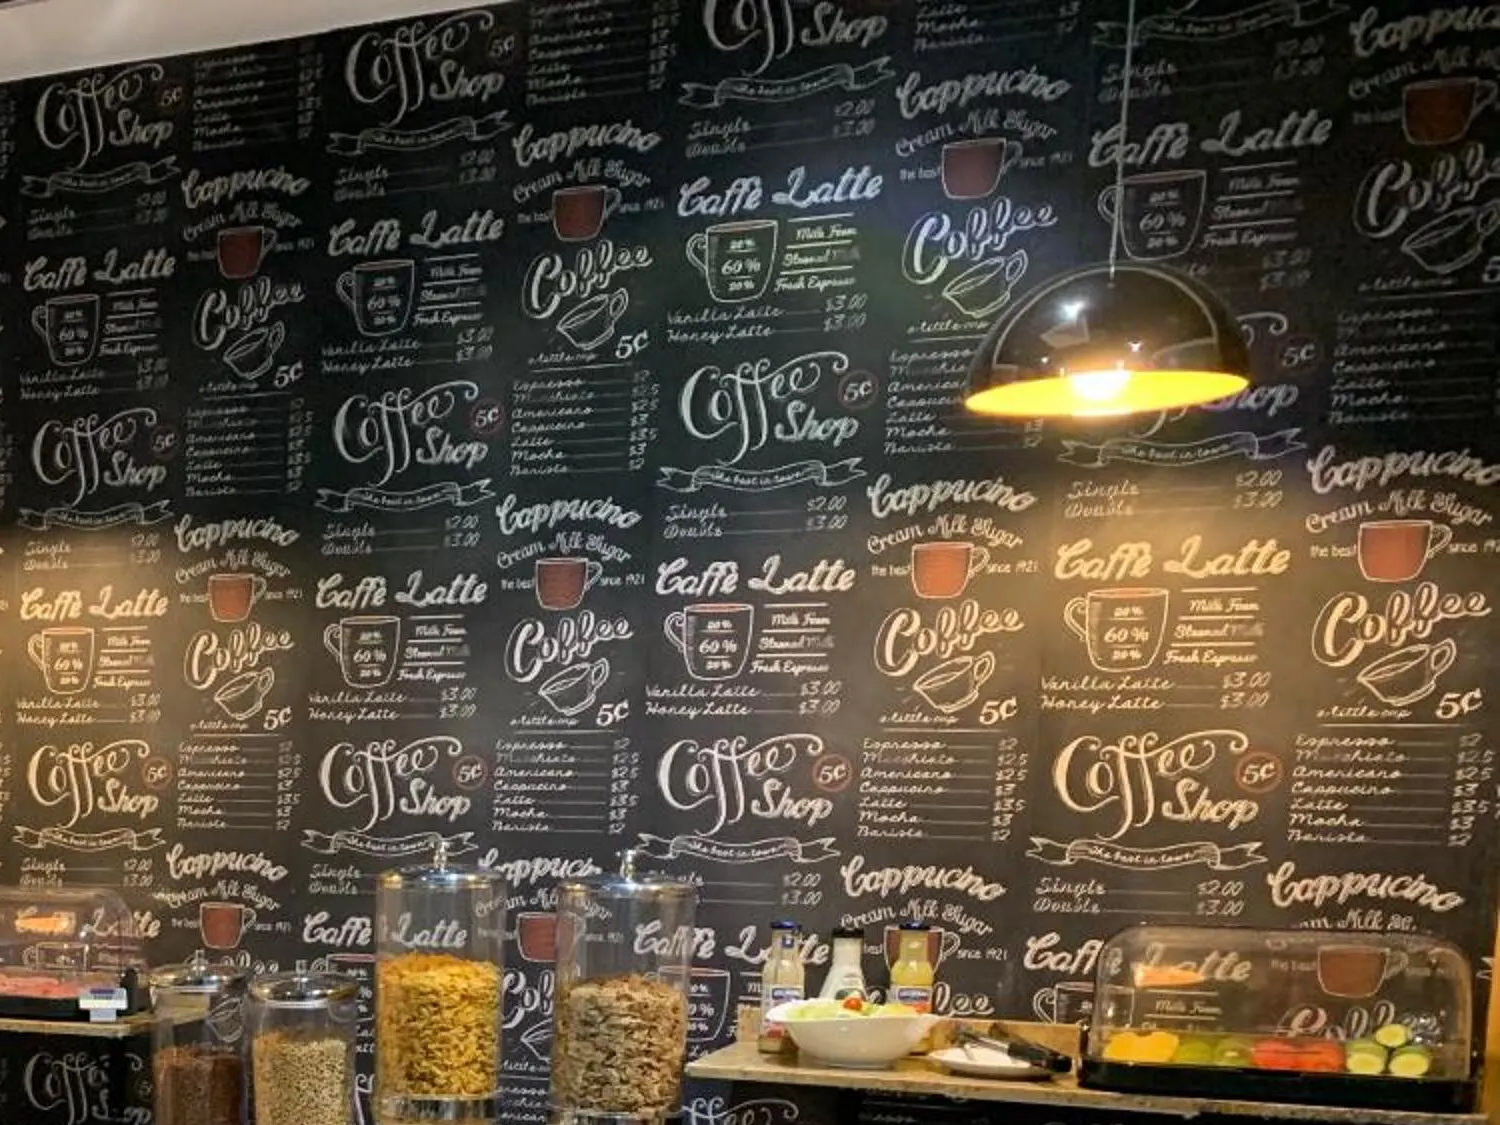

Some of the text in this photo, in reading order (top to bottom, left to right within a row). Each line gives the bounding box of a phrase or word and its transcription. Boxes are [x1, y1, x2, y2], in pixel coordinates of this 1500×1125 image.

[429, 59, 504, 103] Shop
[109, 108, 174, 149] Shop
[771, 166, 883, 208] Latte
[408, 209, 504, 248] Latte
[902, 197, 1057, 284] Coffee
[93, 248, 176, 284] Latte
[521, 240, 653, 320] Coffee
[678, 350, 849, 469] Coffee
[774, 399, 859, 448] Shop
[31, 408, 158, 509] Coffee
[332, 380, 478, 490] Coffee
[415, 425, 488, 470] Shop
[103, 450, 166, 492] Shop
[1306, 501, 1374, 534] Cream
[748, 554, 856, 594] Latte
[1163, 535, 1290, 578] Latte
[87, 584, 168, 618] Latte
[394, 570, 487, 606] Latte
[504, 611, 633, 682] Coffee
[874, 599, 1024, 677] Coffee
[1311, 583, 1490, 667] Coffee
[184, 623, 294, 689] Coffee
[27, 740, 151, 831] Coffee
[97, 777, 159, 819] Shop
[319, 737, 461, 834] Coffee
[400, 777, 471, 822] Shop
[657, 733, 823, 838] Coffee
[751, 778, 833, 827] Shop
[1053, 730, 1249, 843] Coffee
[1162, 778, 1259, 831] Shop
